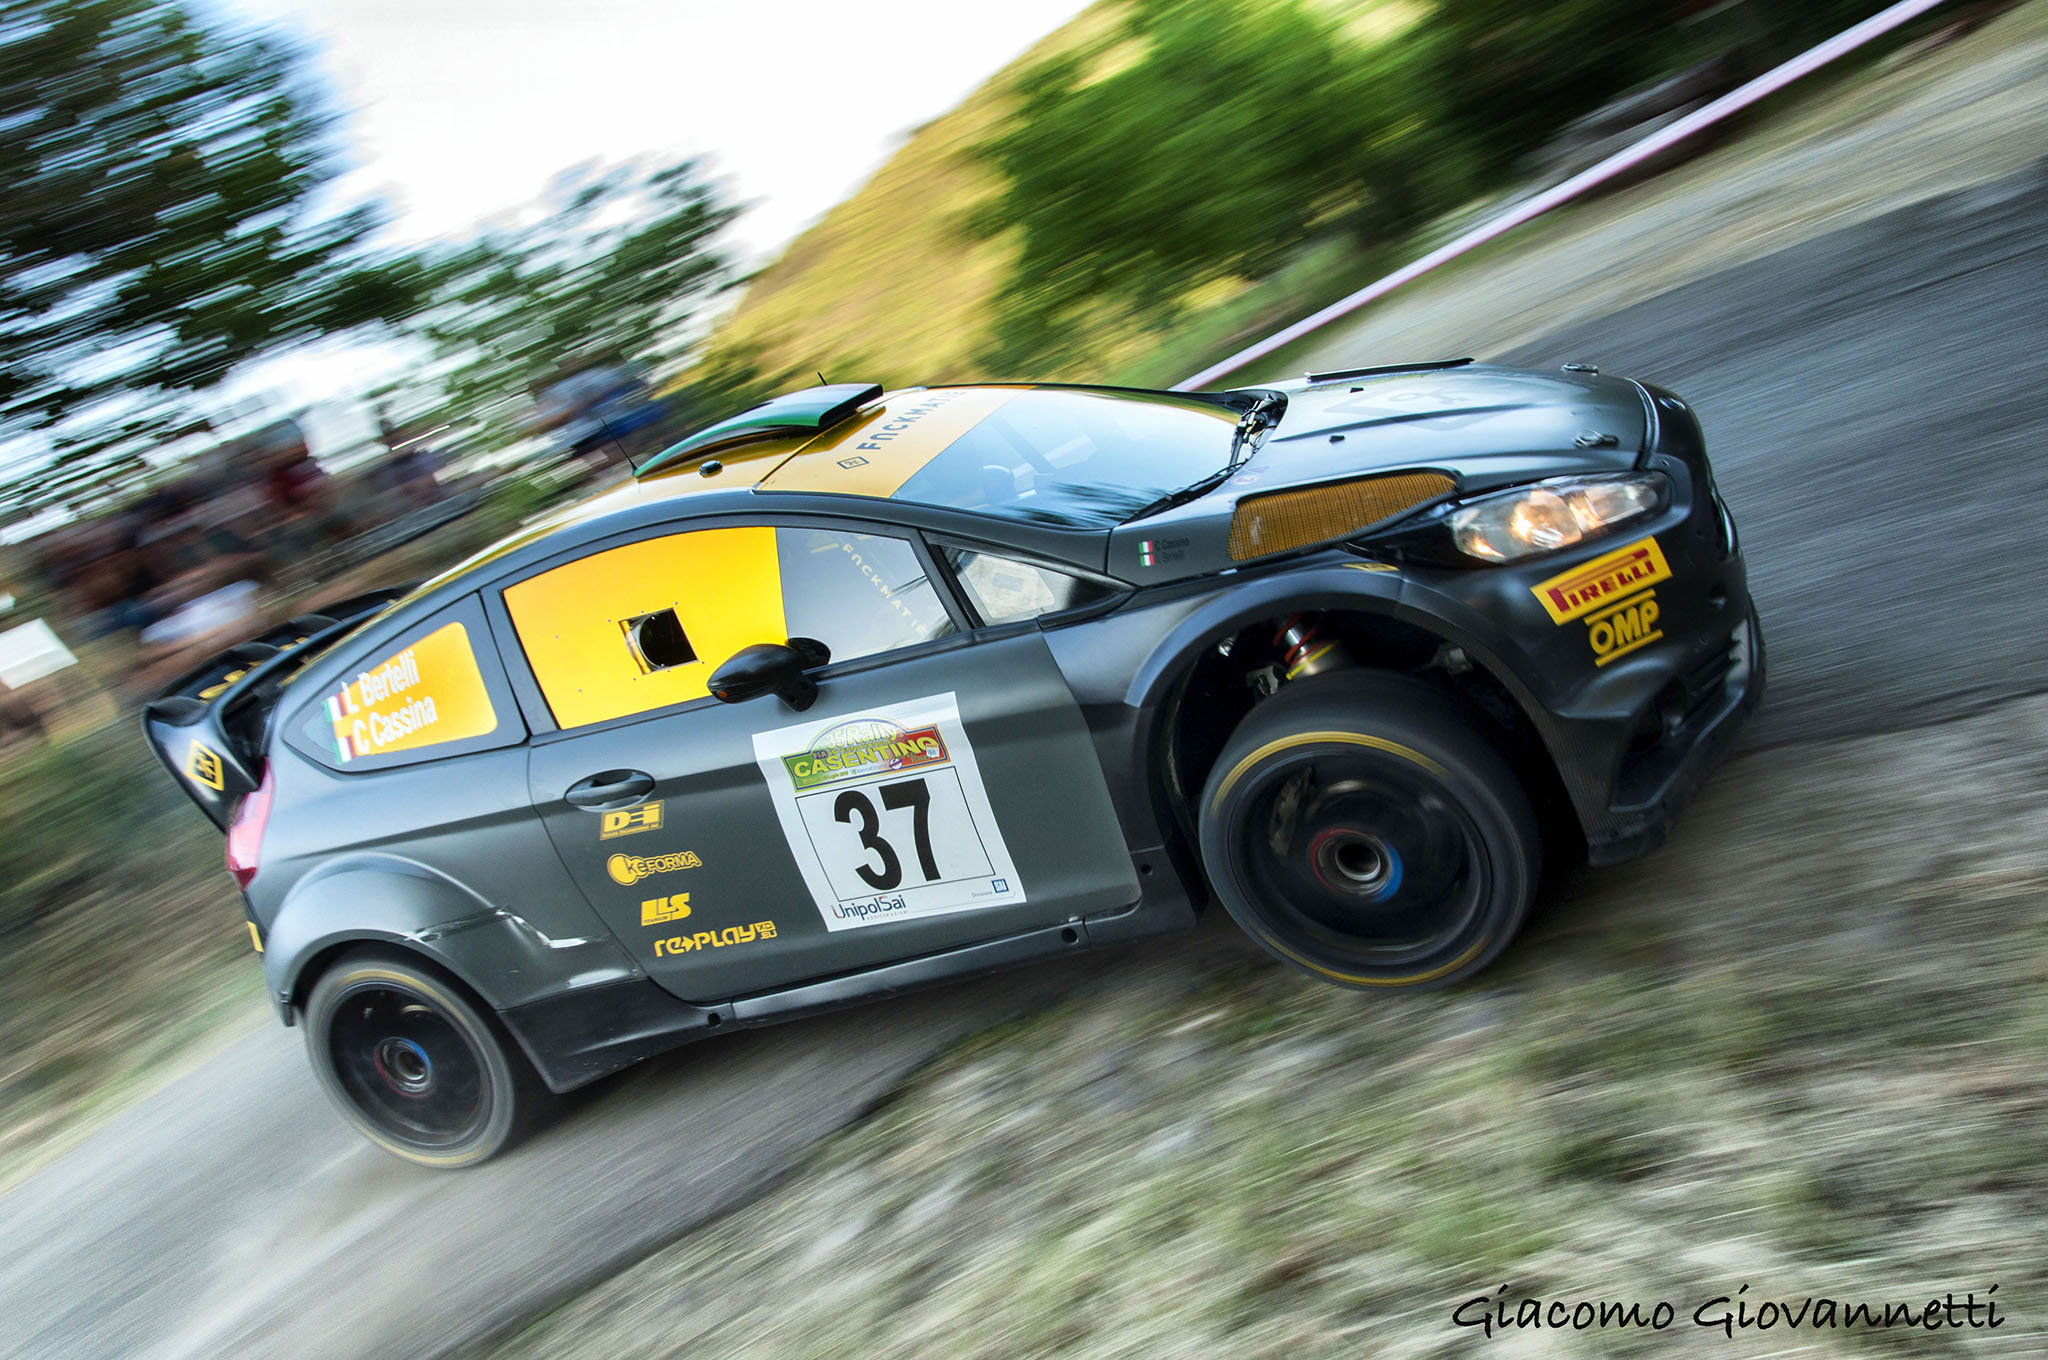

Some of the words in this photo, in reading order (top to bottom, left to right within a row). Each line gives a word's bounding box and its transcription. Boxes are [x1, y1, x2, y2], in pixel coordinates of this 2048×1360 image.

[1547, 548, 1656, 614] PIRELLI
[1589, 599, 1660, 655] OMP
[357, 650, 421, 707] Bertelli
[352, 719, 370, 754] C
[369, 696, 439, 747] Cassina
[846, 723, 897, 746] Rally
[793, 736, 938, 778] CASENTINO
[834, 778, 941, 891] 37
[830, 895, 906, 921] UnipolSai
